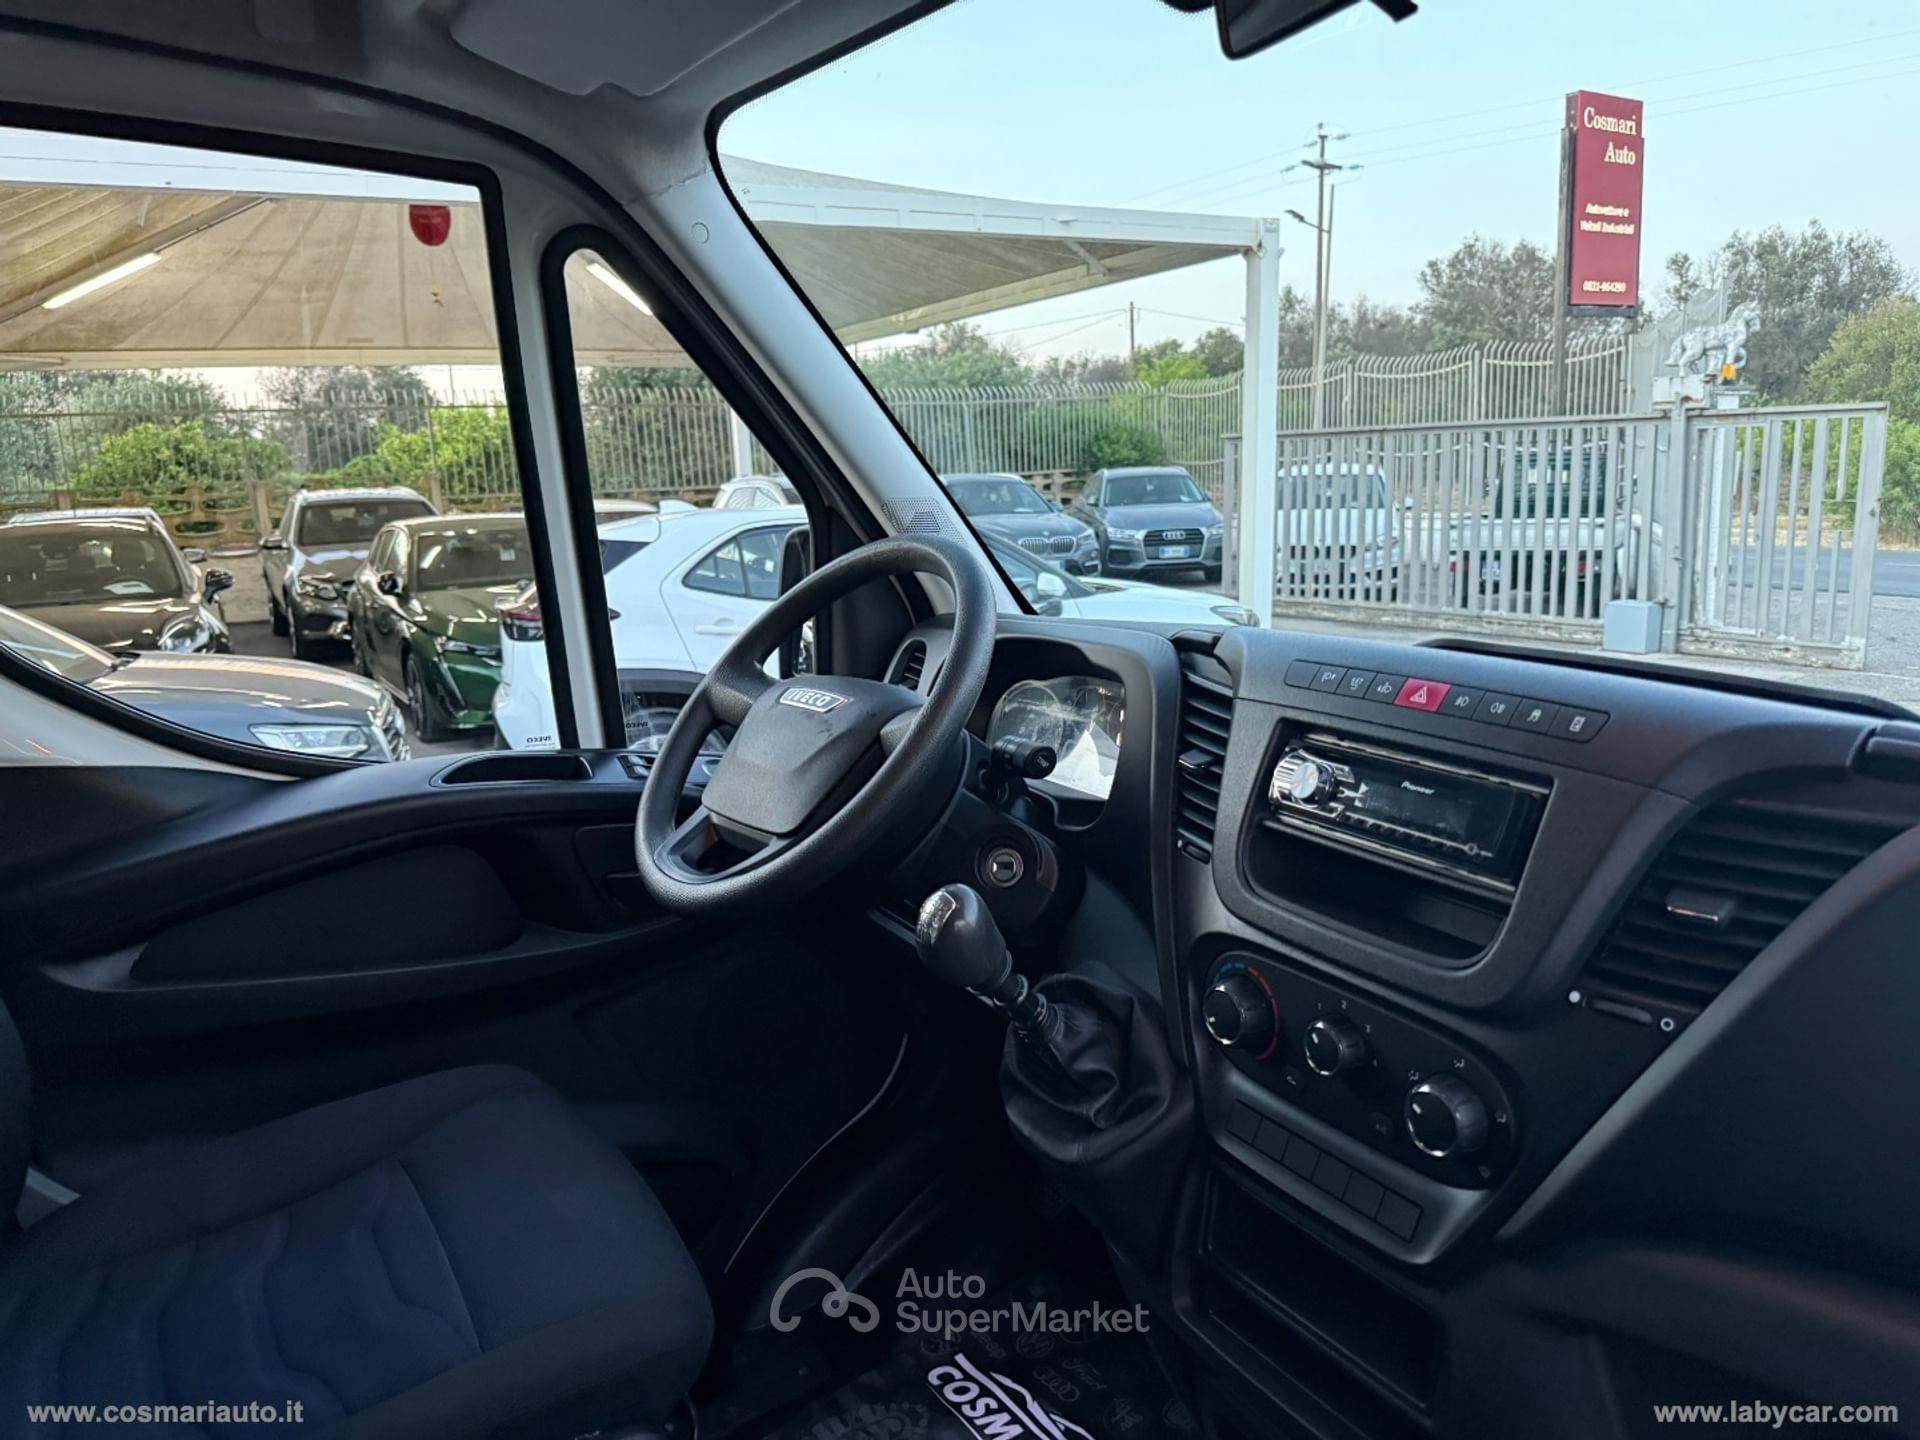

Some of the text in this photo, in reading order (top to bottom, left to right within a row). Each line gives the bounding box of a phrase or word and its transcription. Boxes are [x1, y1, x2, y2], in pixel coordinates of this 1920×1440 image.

[1583, 106, 1637, 135] Cosmari
[1603, 141, 1636, 165] Auto
[787, 689, 832, 707] IVECO
